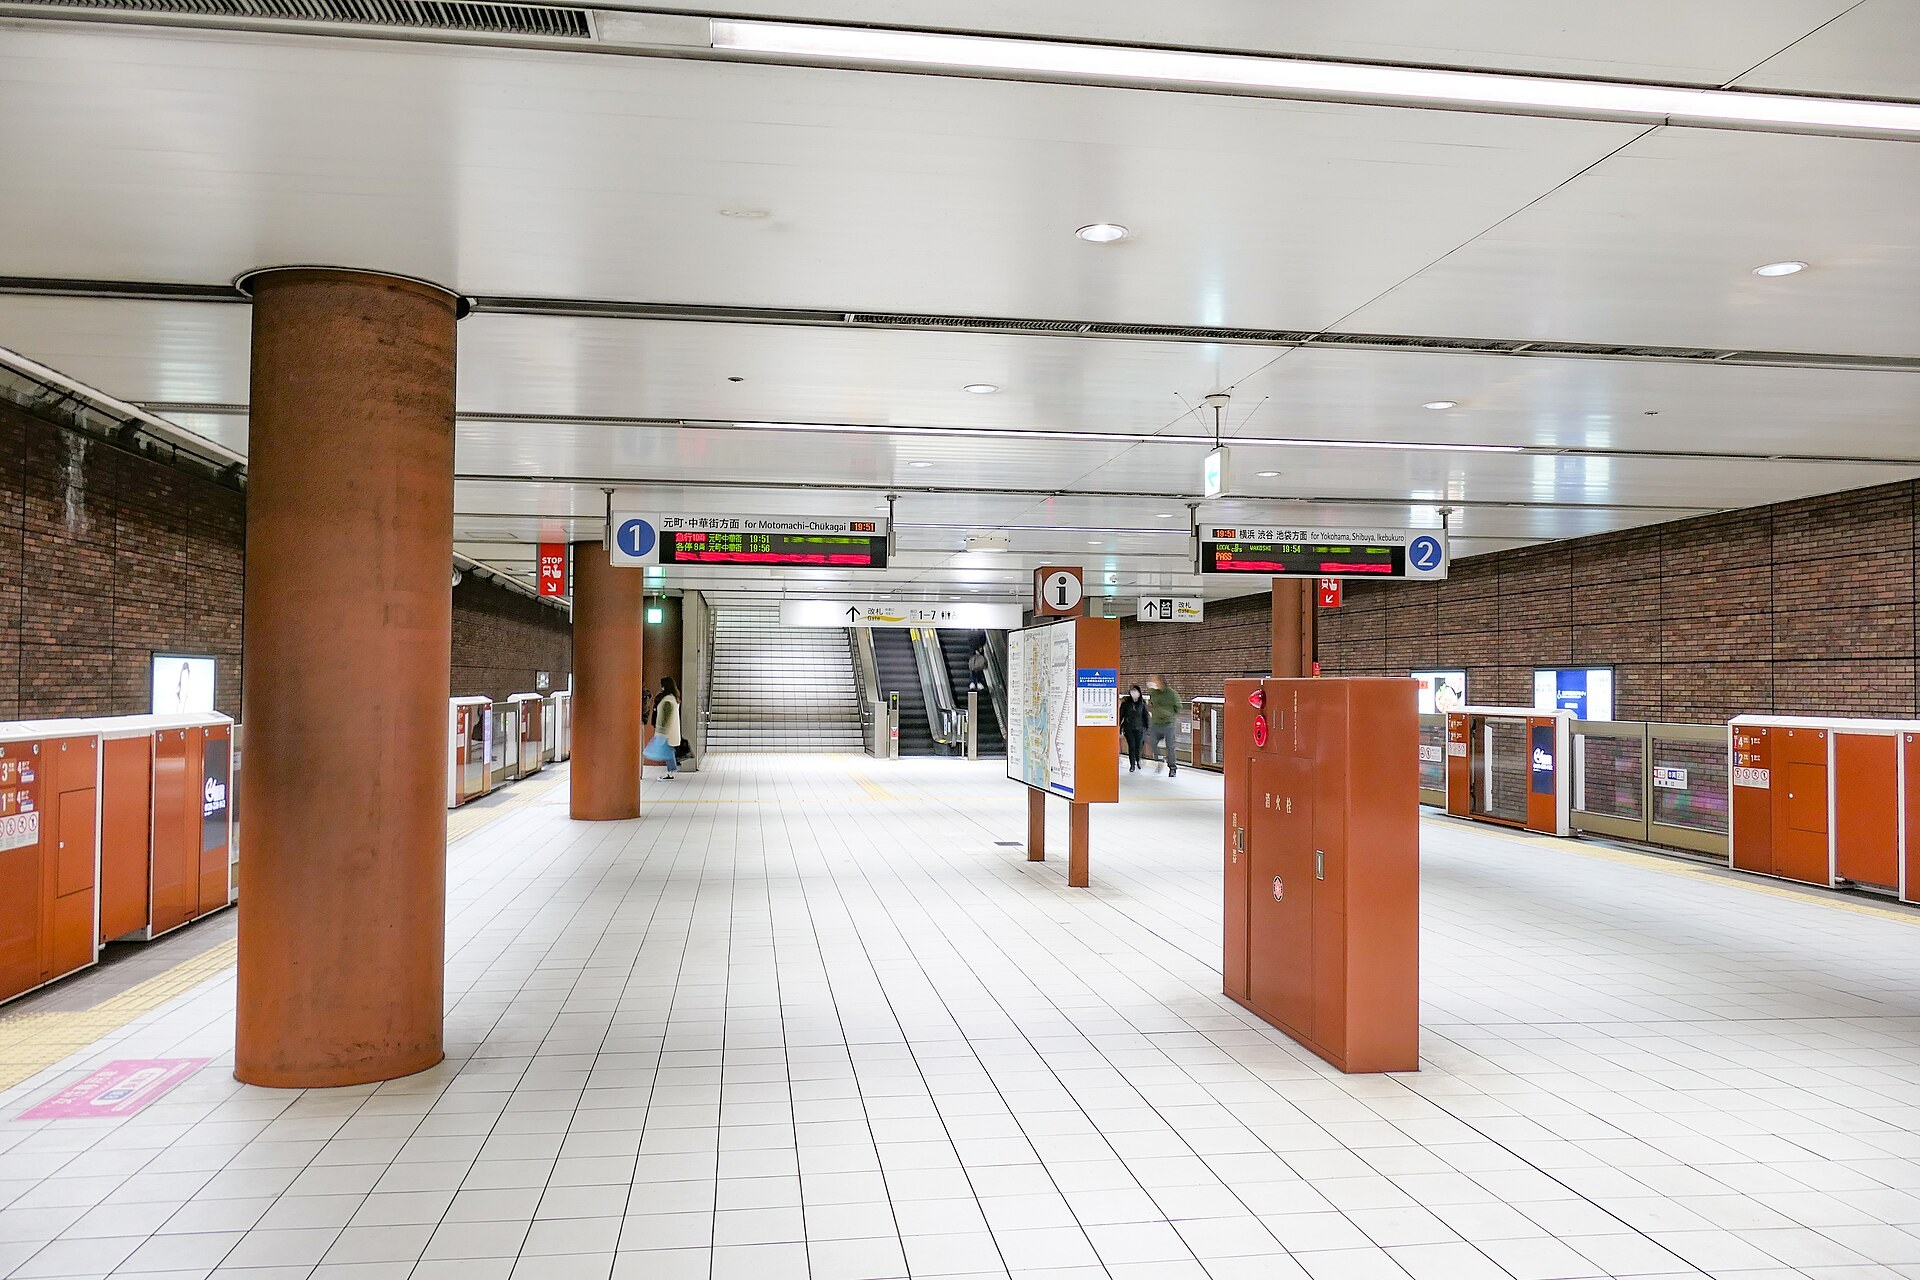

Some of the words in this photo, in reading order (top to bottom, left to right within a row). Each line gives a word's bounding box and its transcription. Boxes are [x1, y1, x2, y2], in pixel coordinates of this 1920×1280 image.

[663, 517, 740, 529] 元町・中華街方面
[744, 520, 757, 529] for
[853, 523, 874, 532] 19:51
[629, 524, 640, 552] 1
[1216, 529, 1235, 538] 19:51
[1239, 529, 1256, 540] 横浜
[1257, 529, 1274, 540] 渋谷
[1276, 530, 1308, 541] 池袋方面
[1310, 531, 1319, 541] for
[1320, 531, 1351, 541] Yokohama,
[1351, 532, 1376, 543] Shibuya,
[1376, 533, 1405, 542] Ikebukuro
[749, 534, 770, 544] 19:51
[1282, 544, 1301, 554] 19:54
[1417, 541, 1434, 566] 2
[541, 556, 563, 565] STOP
[1215, 552, 1233, 561] PASS
[867, 607, 884, 616] 改札
[2, 762, 8, 782] 3
